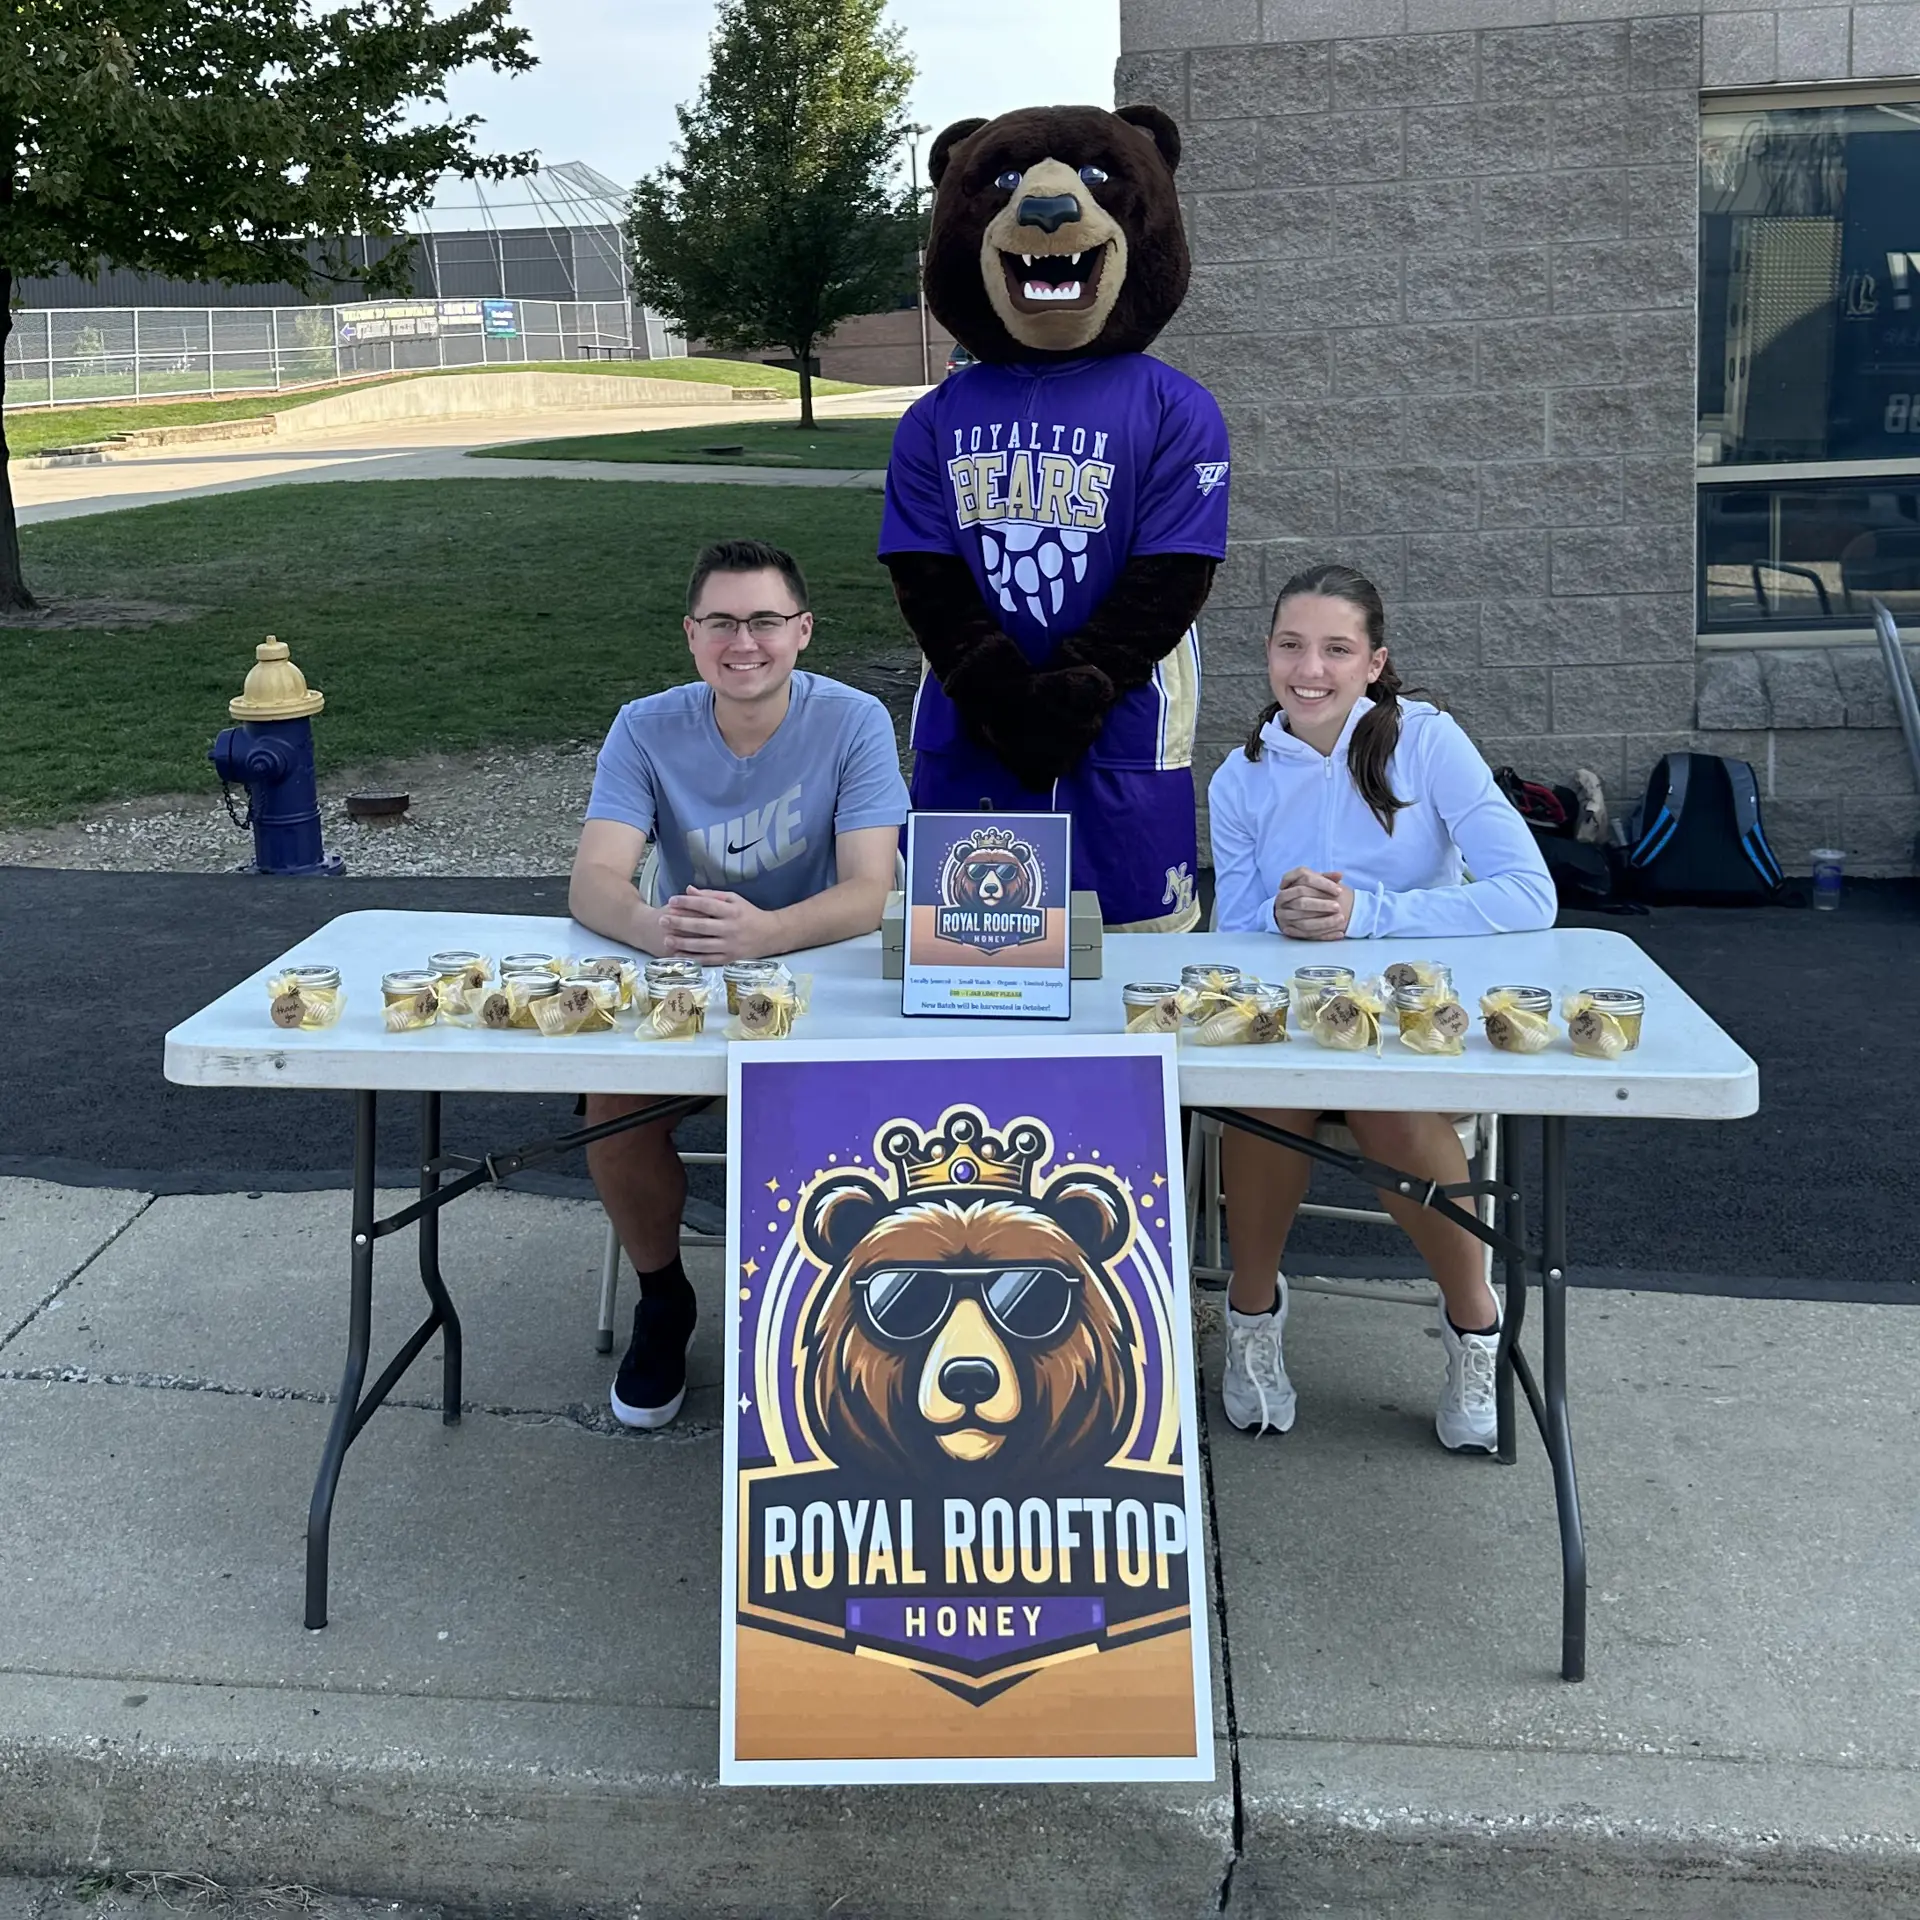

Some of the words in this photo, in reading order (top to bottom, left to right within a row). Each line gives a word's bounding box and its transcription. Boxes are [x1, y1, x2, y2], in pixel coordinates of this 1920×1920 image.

[954, 422, 1109, 459] ROYALTON
[947, 450, 1115, 533] BEARS
[687, 784, 807, 887] NIKE
[943, 913, 980, 933] ROYAL
[983, 913, 1040, 934] ROOFTOP
[974, 935, 1006, 943] HONEY
[921, 1001, 936, 1009] New
[764, 1498, 926, 1594] ROYAL
[943, 1496, 1187, 1590] ROOFTOP
[905, 1605, 1043, 1637] HONEY
